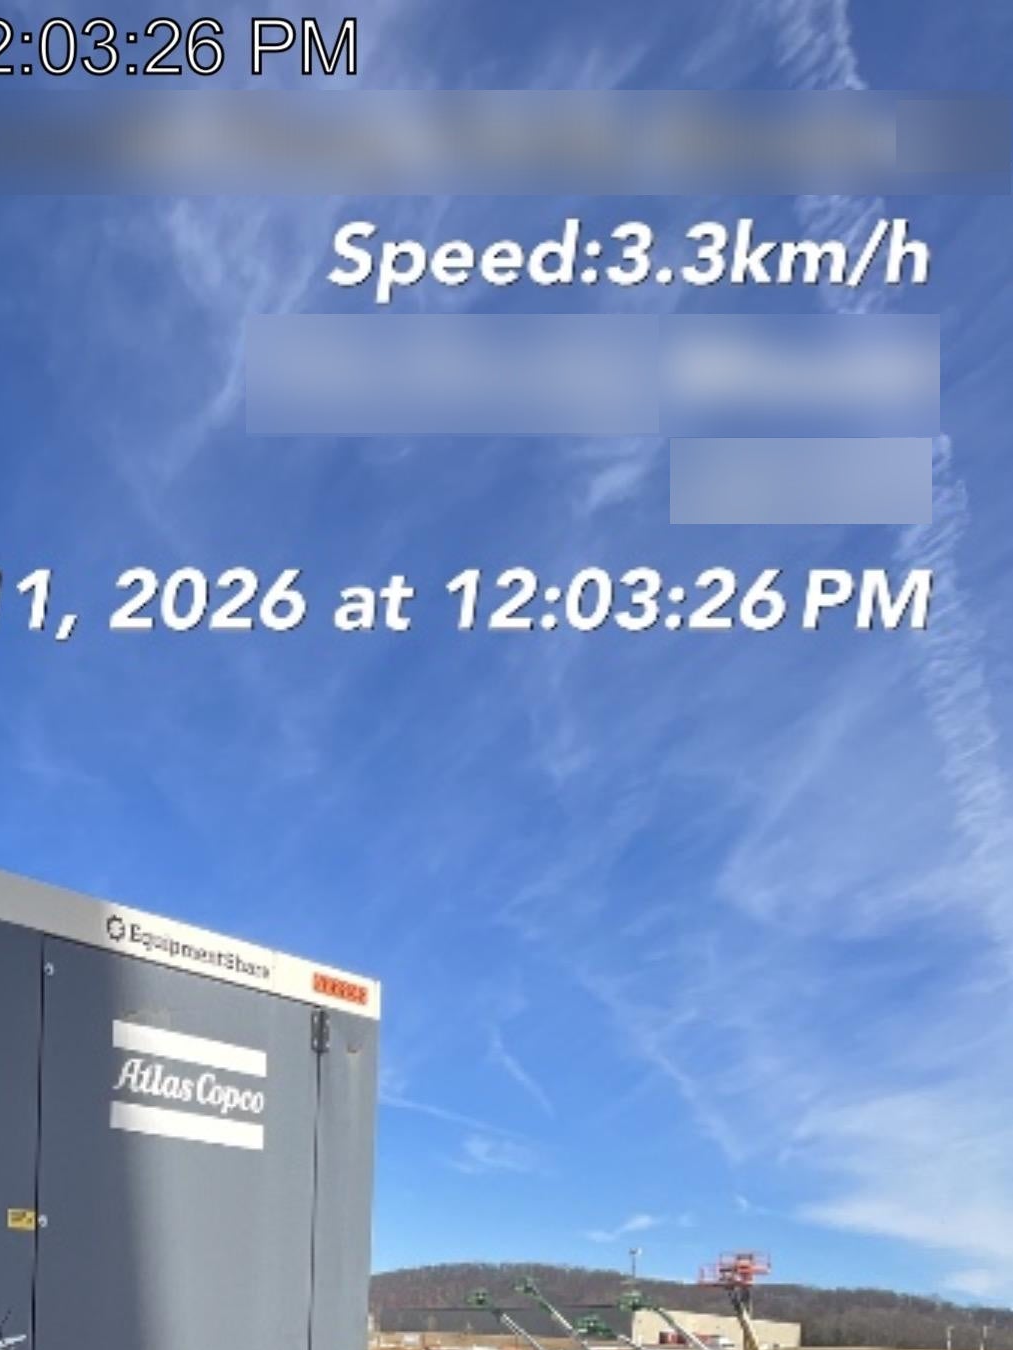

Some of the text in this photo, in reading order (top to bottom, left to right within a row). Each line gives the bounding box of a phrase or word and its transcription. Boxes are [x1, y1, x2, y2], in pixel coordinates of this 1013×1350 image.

[130, 924, 270, 979] EquipmentShare
[112, 1058, 265, 1115] Atlas Copco
